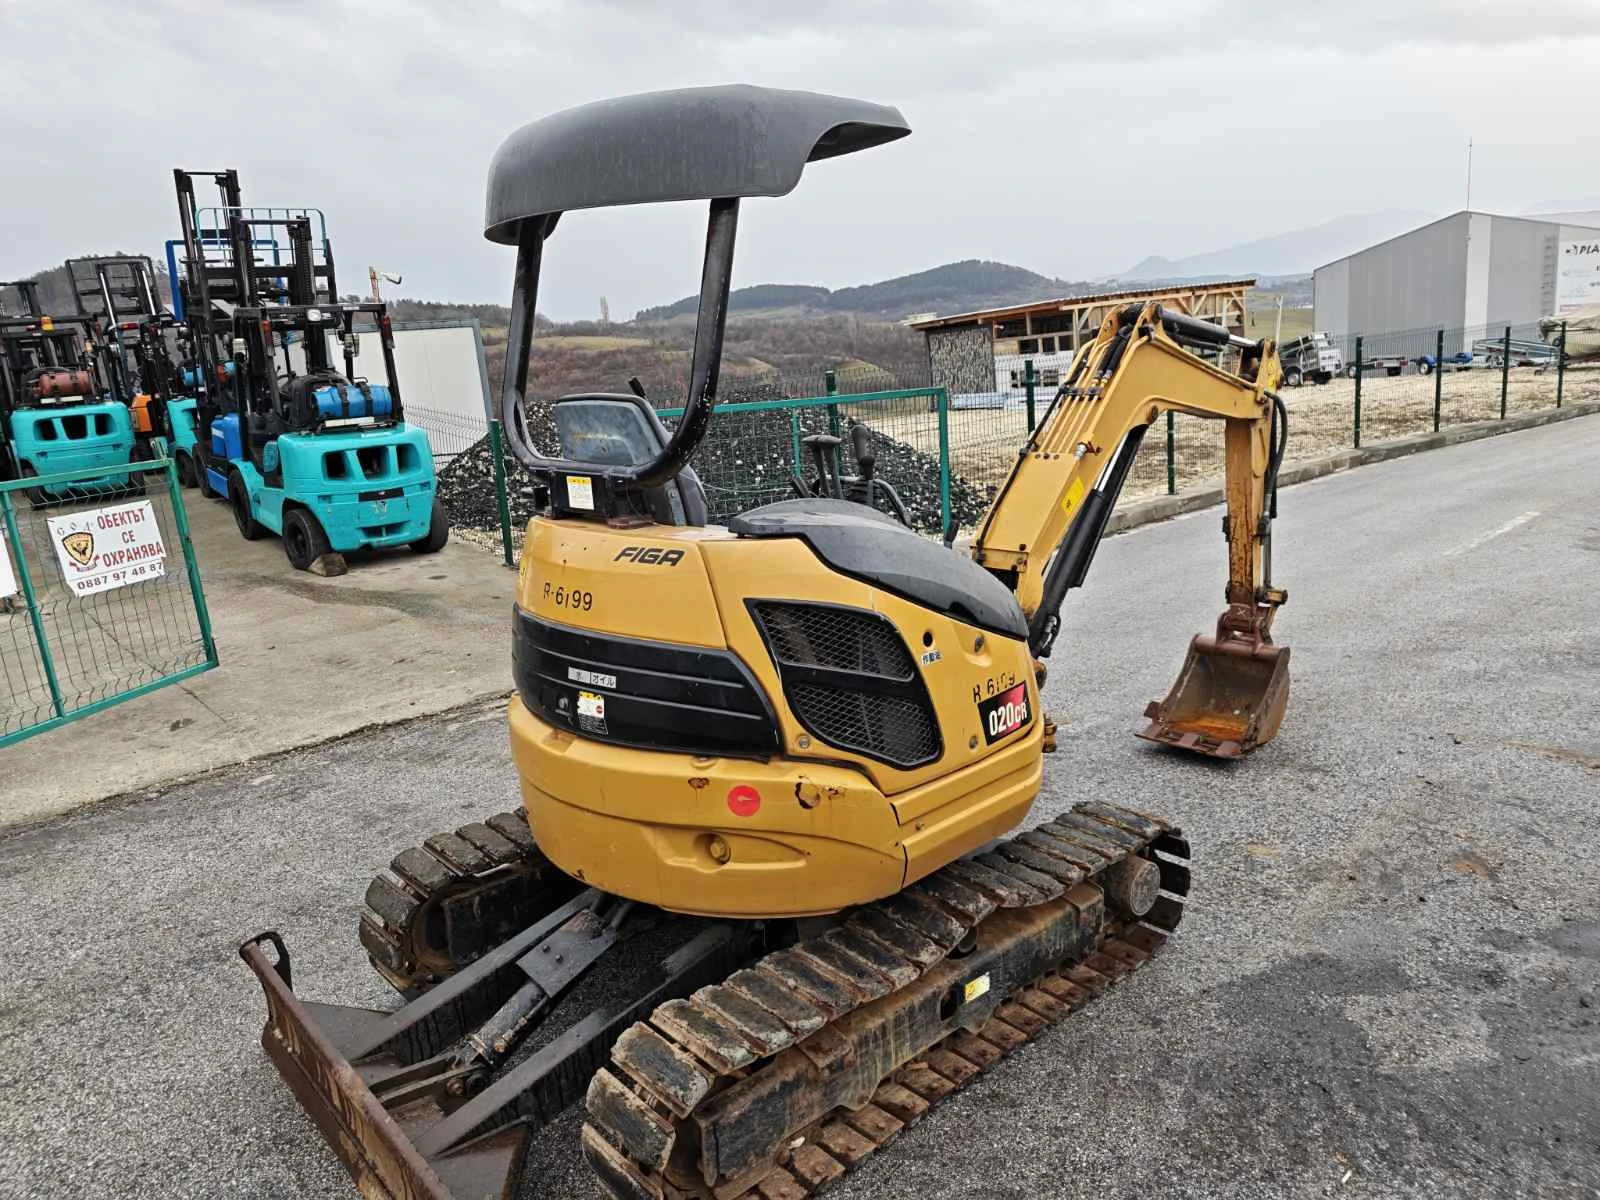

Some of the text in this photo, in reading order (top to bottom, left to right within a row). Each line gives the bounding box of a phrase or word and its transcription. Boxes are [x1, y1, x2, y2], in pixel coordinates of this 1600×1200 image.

[97, 508, 145, 529] ОБЕКТЪТ
[121, 530, 136, 544] СЕ
[102, 541, 164, 568] ОХРАНЯВА
[613, 547, 685, 567] FIGA
[77, 562, 162, 590] 0887 97 48 87
[543, 582, 593, 611] R-6199
[592, 673, 615, 688] オイル
[989, 702, 1027, 736] 020CR
